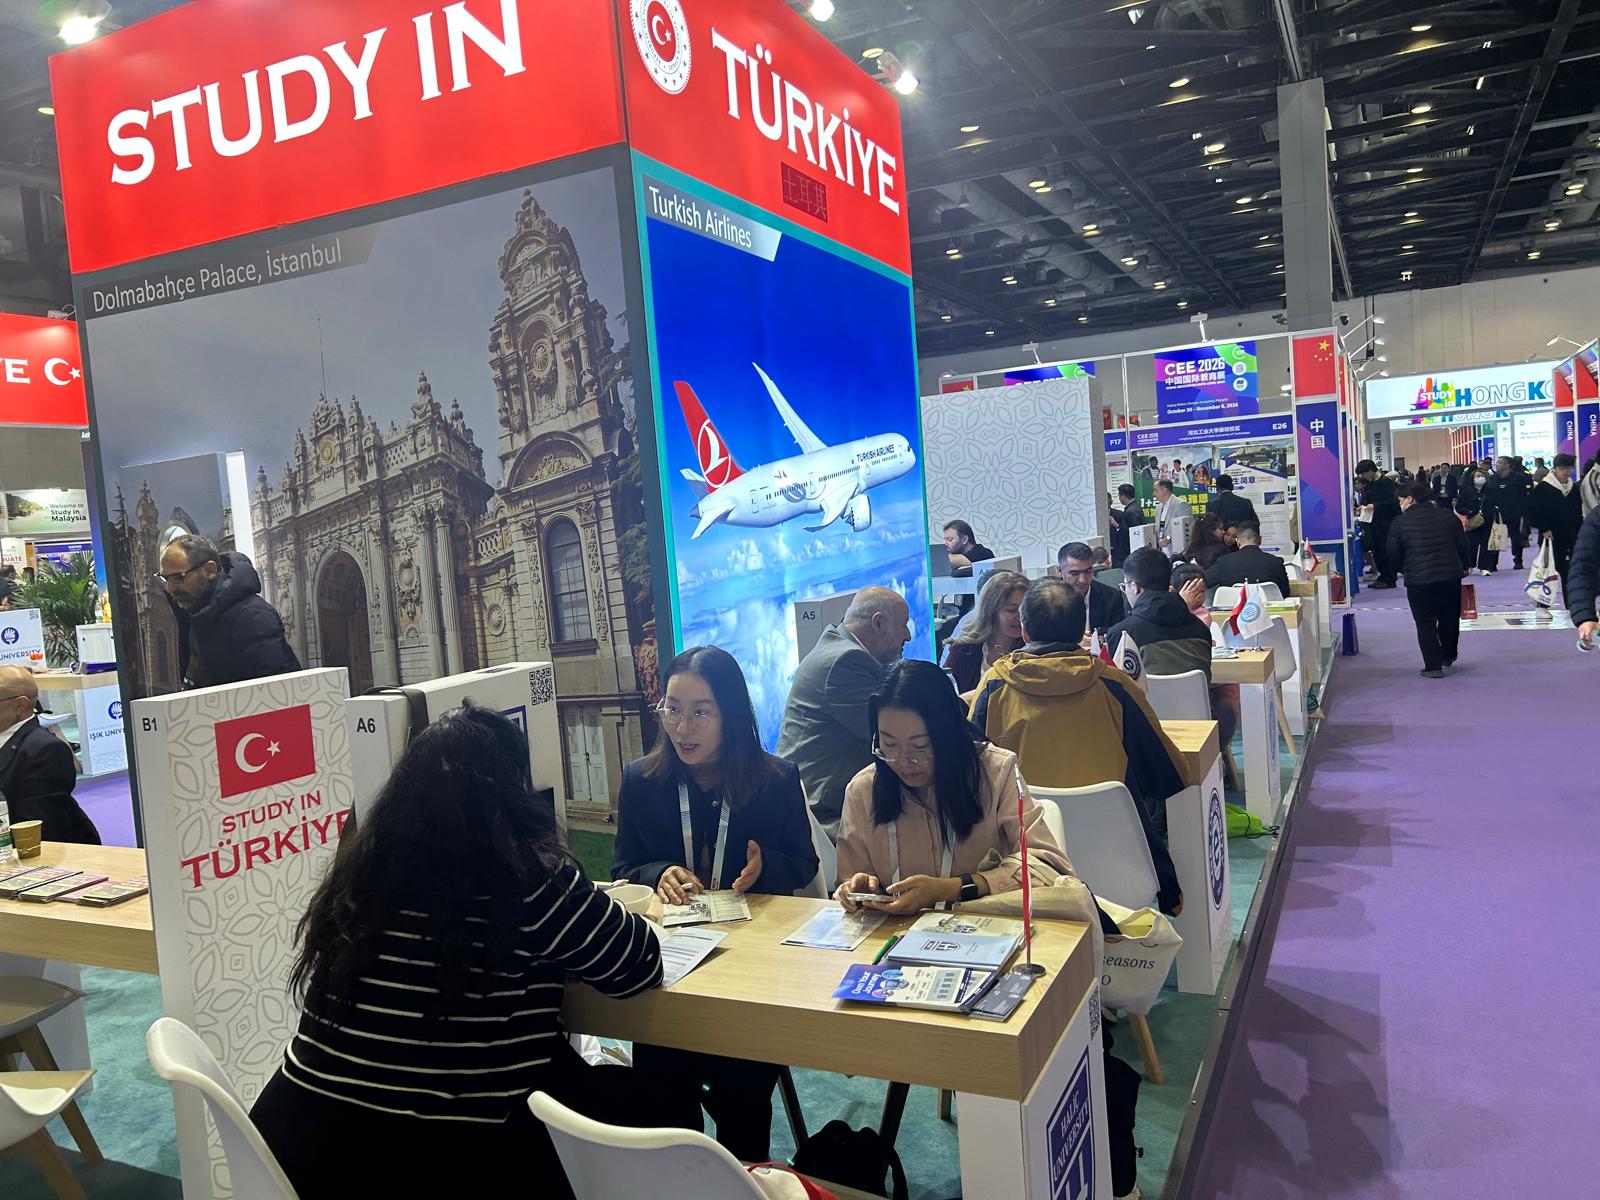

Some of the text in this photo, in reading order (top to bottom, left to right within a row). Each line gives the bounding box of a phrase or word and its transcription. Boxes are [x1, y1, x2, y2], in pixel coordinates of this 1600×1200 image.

[107, 28, 387, 185] STUDY
[412, 0, 526, 101] IN
[711, 27, 900, 217] TÜRKİYE
[783, 167, 827, 219] 土耳其
[648, 185, 752, 250] Turkish Airlines
[93, 239, 342, 314] Dolmabahçe Palace, İstanbul
[0, 357, 30, 384] E
[1164, 357, 1225, 376] CEE 2026
[1420, 390, 1452, 402] STUDY
[1455, 382, 1526, 407] HONG
[1272, 422, 1287, 430] E26
[1566, 420, 1574, 441] CHINA
[1589, 414, 1597, 437] CHINA
[857, 444, 894, 462] TURKISH AIRLINES
[1109, 438, 1121, 446] F17
[51, 508, 71, 516] Study
[51, 514, 87, 523] Malaysia
[802, 611, 816, 621] A5
[142, 716, 158, 732] B1
[356, 717, 376, 734] A6
[221, 790, 322, 834] STUDY IN
[851, 971, 871, 995] Own Your
[862, 973, 882, 994] Journey
[1053, 1097, 1088, 1182] UNIVERSITY
